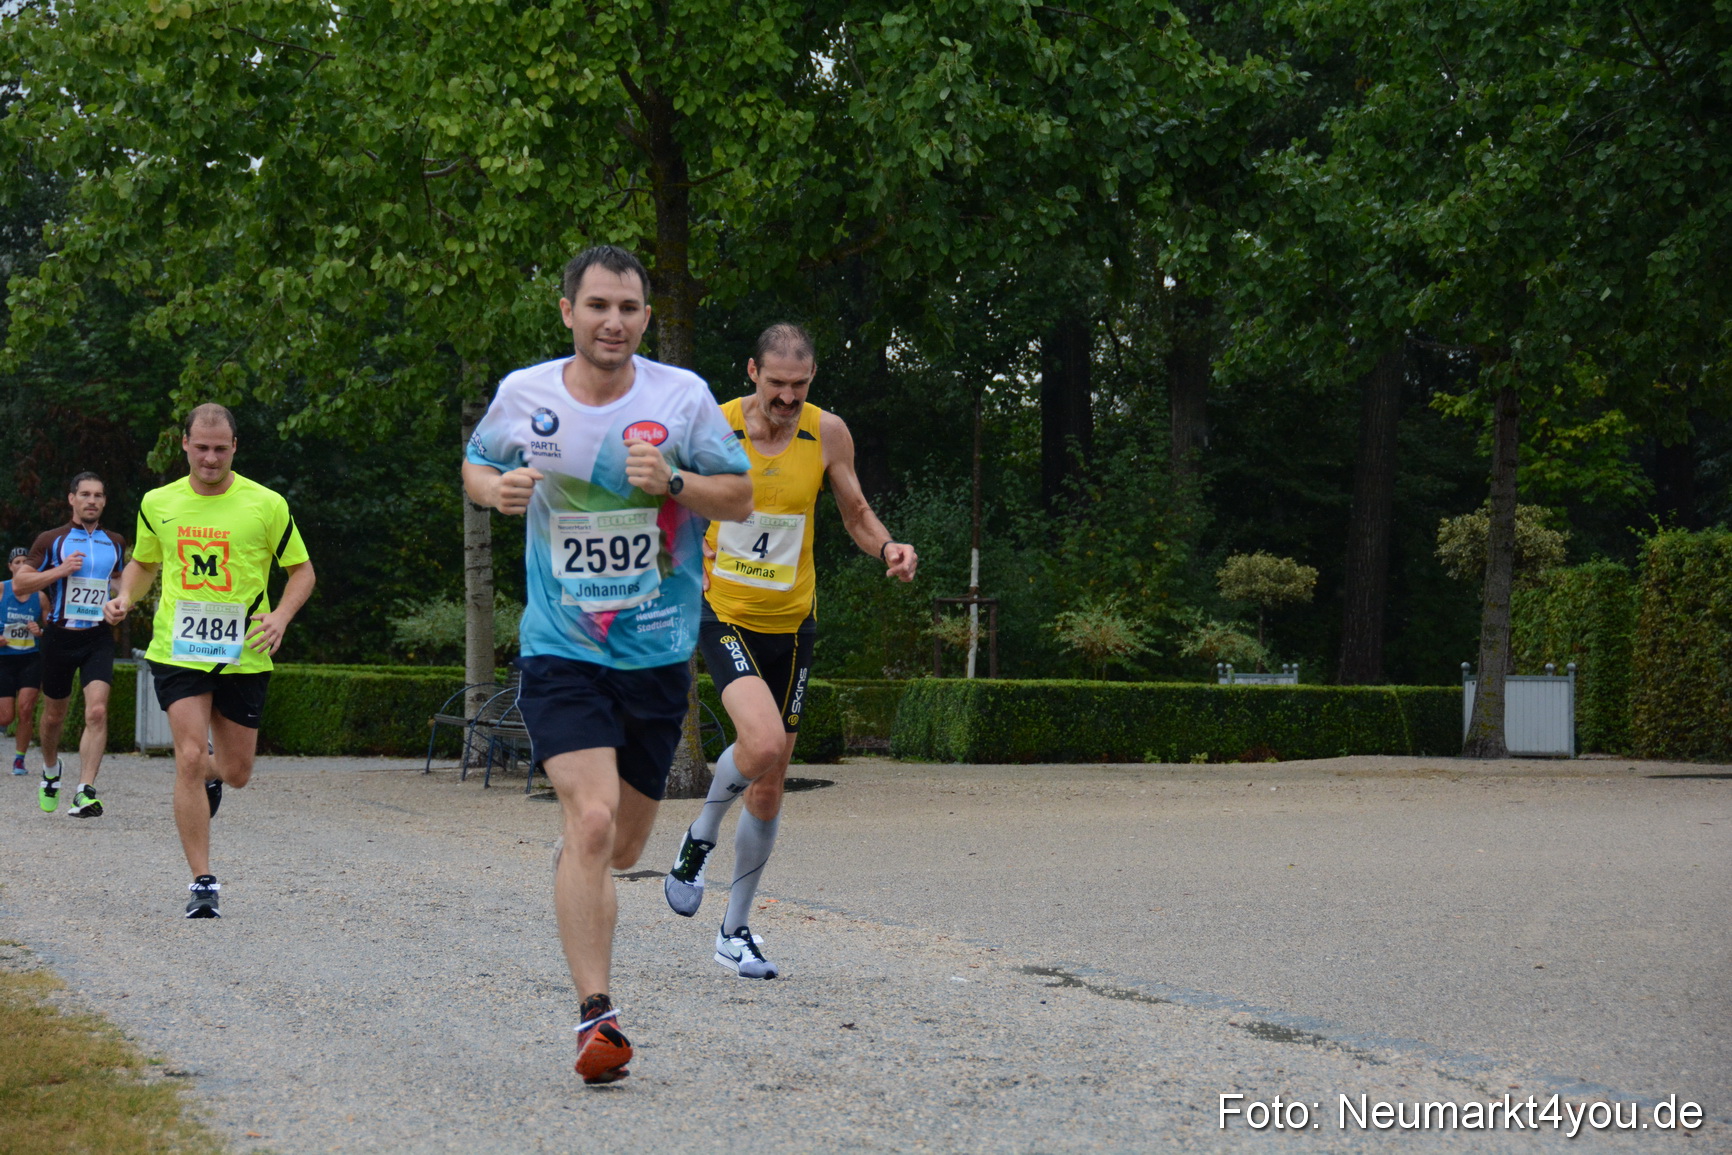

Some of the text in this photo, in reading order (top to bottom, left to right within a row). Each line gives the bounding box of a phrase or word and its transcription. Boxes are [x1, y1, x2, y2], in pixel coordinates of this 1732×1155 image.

[531, 441, 561, 451] PARTL
[598, 514, 648, 528] BOCK
[760, 516, 797, 527] BOCK
[177, 526, 231, 539] Müller
[752, 532, 770, 559] 4
[563, 534, 651, 573] 2592
[191, 554, 219, 577] M
[735, 561, 776, 578] Thomas
[71, 587, 106, 605] 2727
[576, 582, 641, 597] Johannes
[7, 611, 35, 622] ERDINGER
[205, 605, 240, 614] BOCK
[181, 616, 238, 641] 2484
[636, 616, 675, 633] Stadtlauf
[188, 644, 227, 656] Dominik
